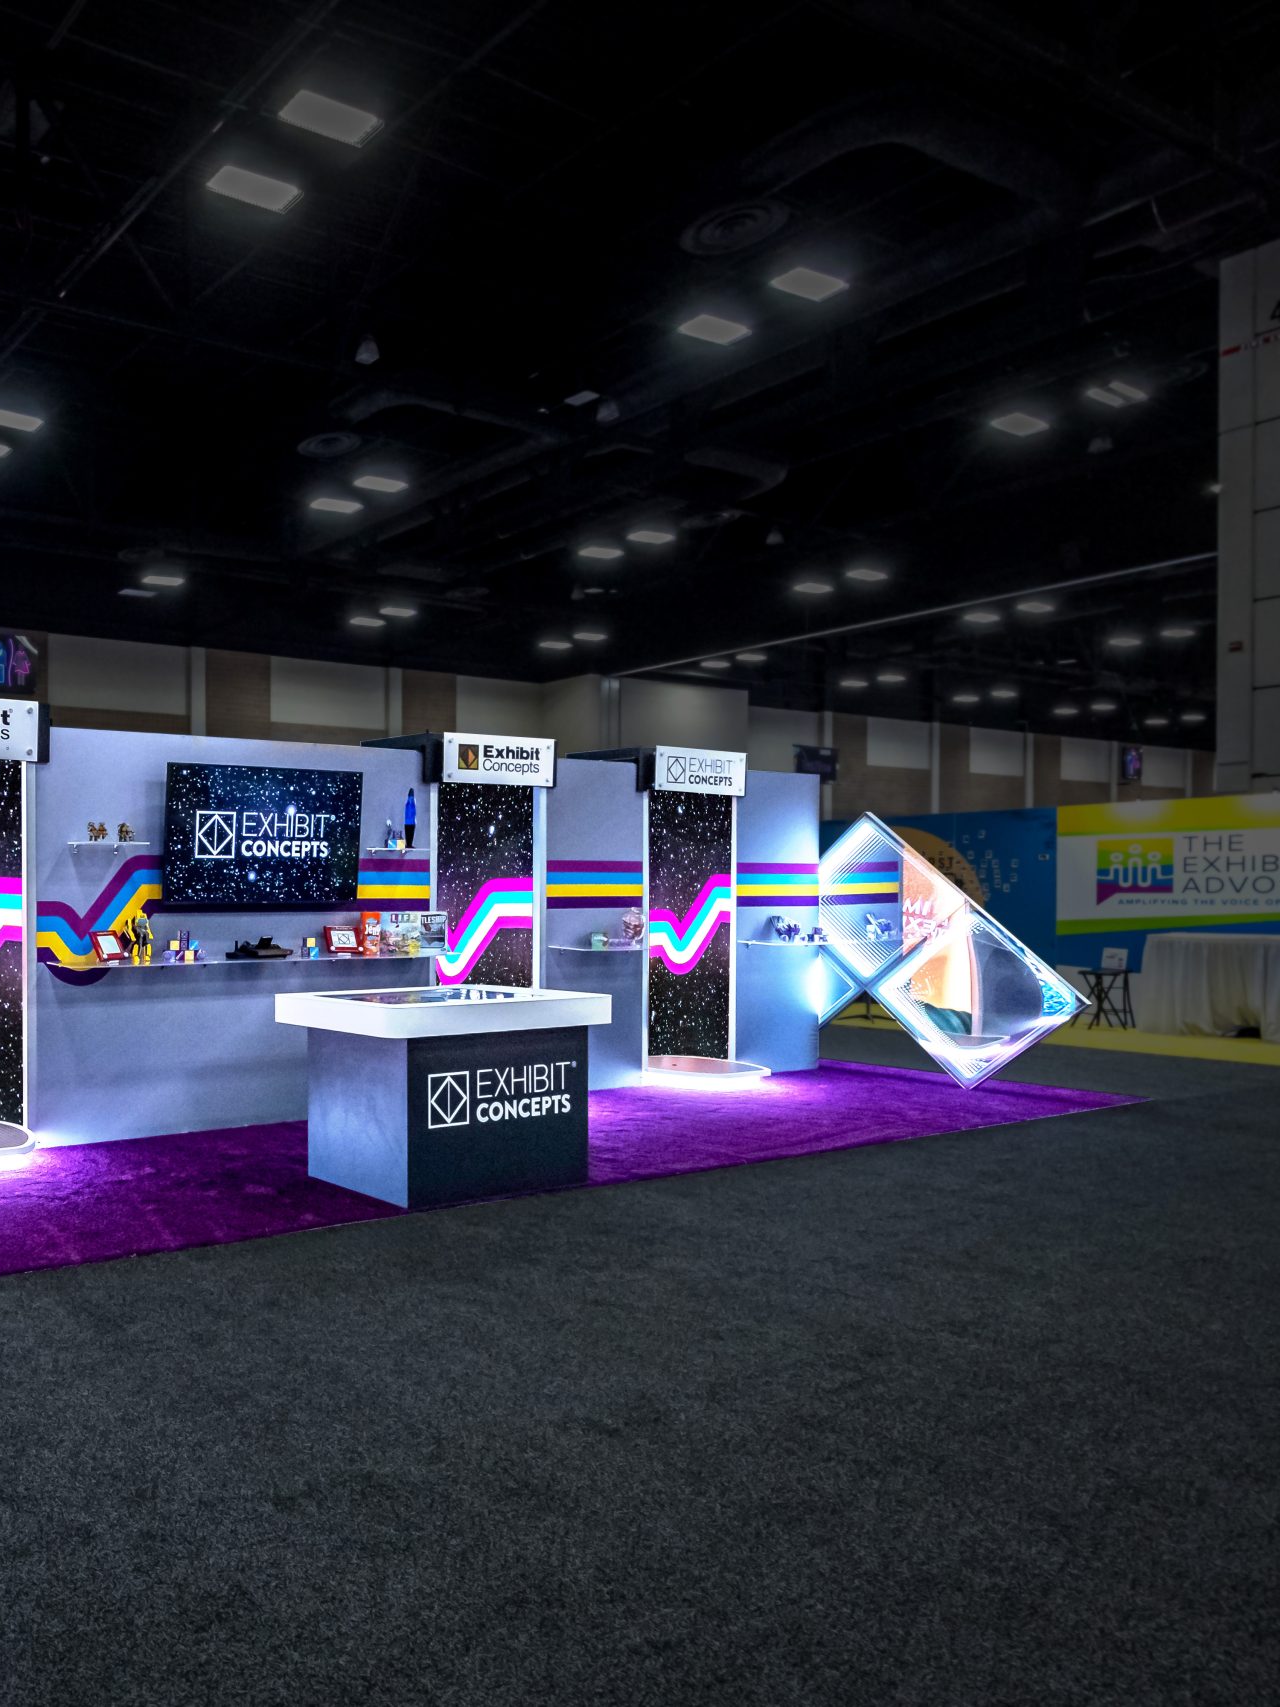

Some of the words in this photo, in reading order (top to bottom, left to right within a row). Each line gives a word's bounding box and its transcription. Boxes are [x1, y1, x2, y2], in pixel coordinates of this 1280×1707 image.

[483, 745, 540, 761] Exhibit
[482, 758, 540, 775] Concepts
[689, 757, 733, 774] EXHIBIT
[688, 775, 733, 787] CONCEPTS
[242, 812, 330, 838] EXHIBIT
[241, 840, 329, 858] CONCEPTS
[1183, 834, 1244, 852] THE
[1183, 854, 1280, 873] EXHIB
[1182, 876, 1276, 894] ADVO
[1117, 898, 1188, 906] AMPLIFYING
[1194, 898, 1216, 906] THE
[1222, 898, 1260, 906] VOICE
[391, 913, 417, 922] LIFE
[476, 1061, 571, 1098] EXHIBIT
[476, 1094, 571, 1123] CONCEPTS
